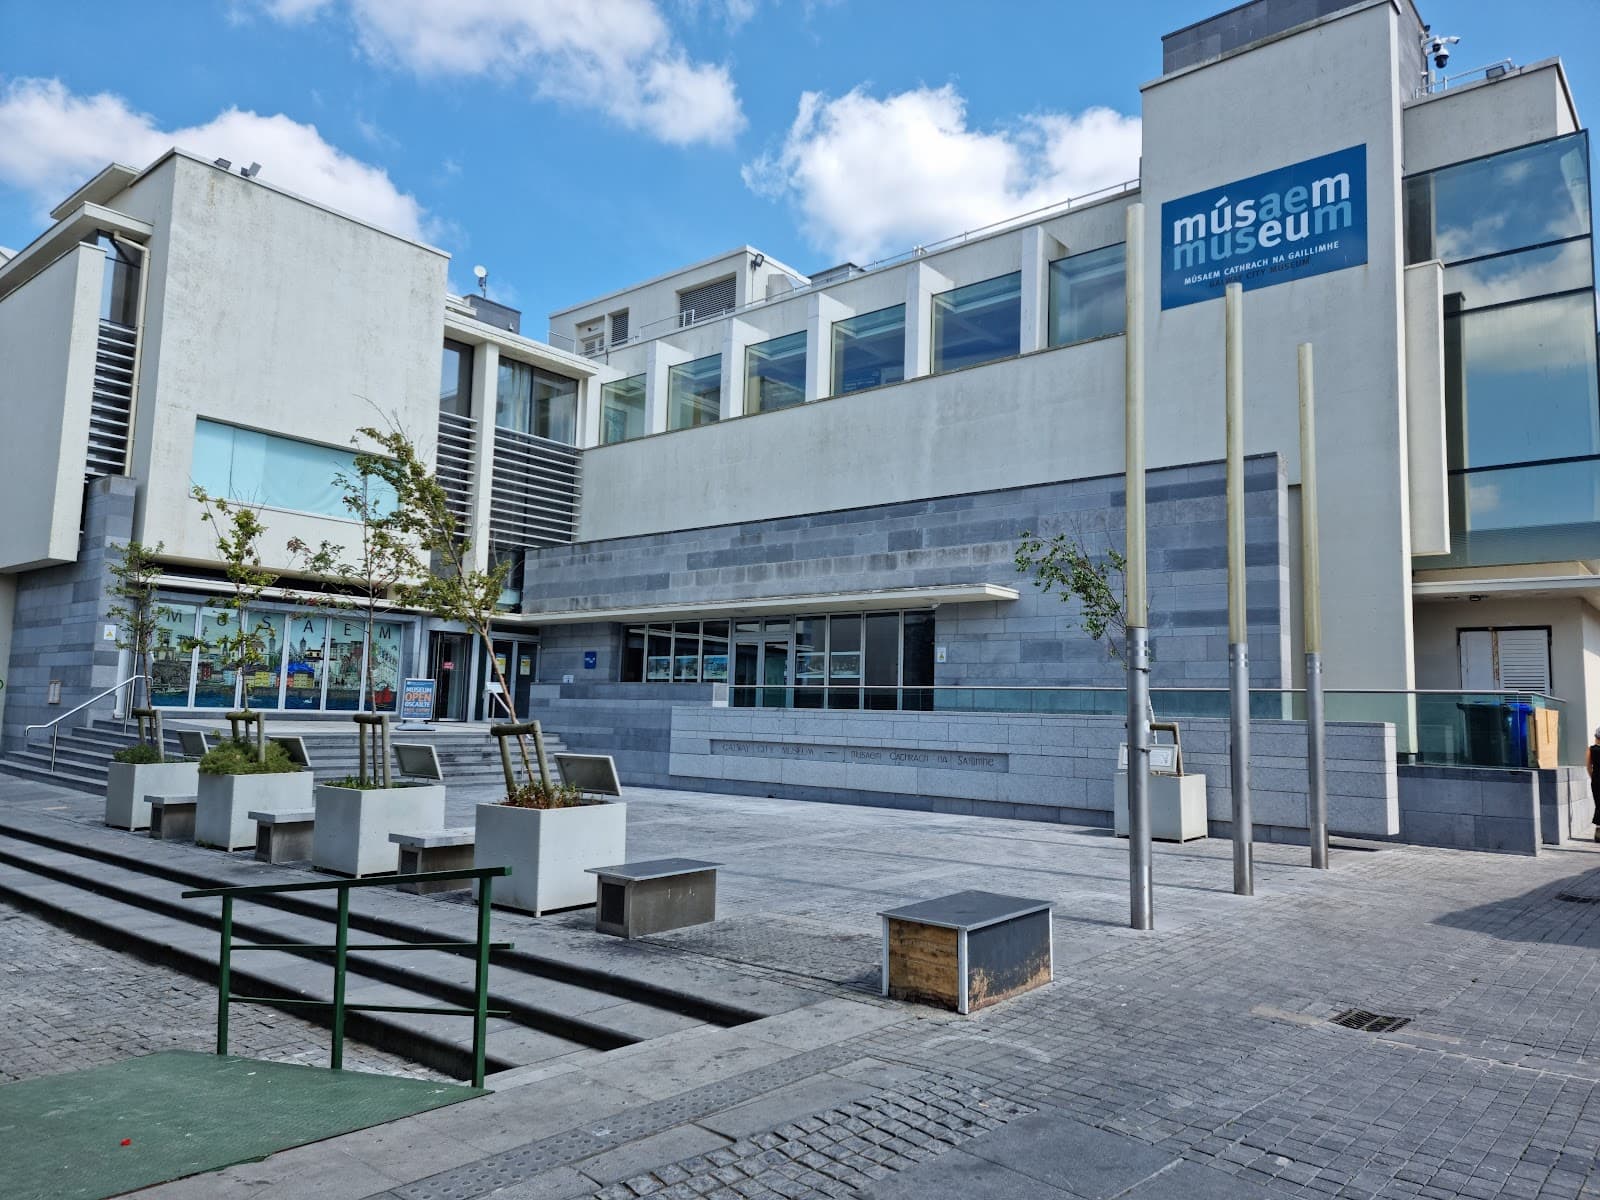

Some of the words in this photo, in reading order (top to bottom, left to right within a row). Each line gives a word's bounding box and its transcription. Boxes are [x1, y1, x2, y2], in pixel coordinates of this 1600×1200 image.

[1173, 172, 1350, 245] músaem
[1173, 200, 1352, 271] museum
[1184, 270, 1221, 286] MÚSAEM
[1224, 258, 1269, 276] CATHRACH
[1272, 254, 1285, 264] NA
[1288, 240, 1340, 260] GAILLIMHE
[1246, 268, 1266, 280] CITY
[1269, 258, 1311, 274] MUSEUM
[405, 692, 432, 702] OPEN
